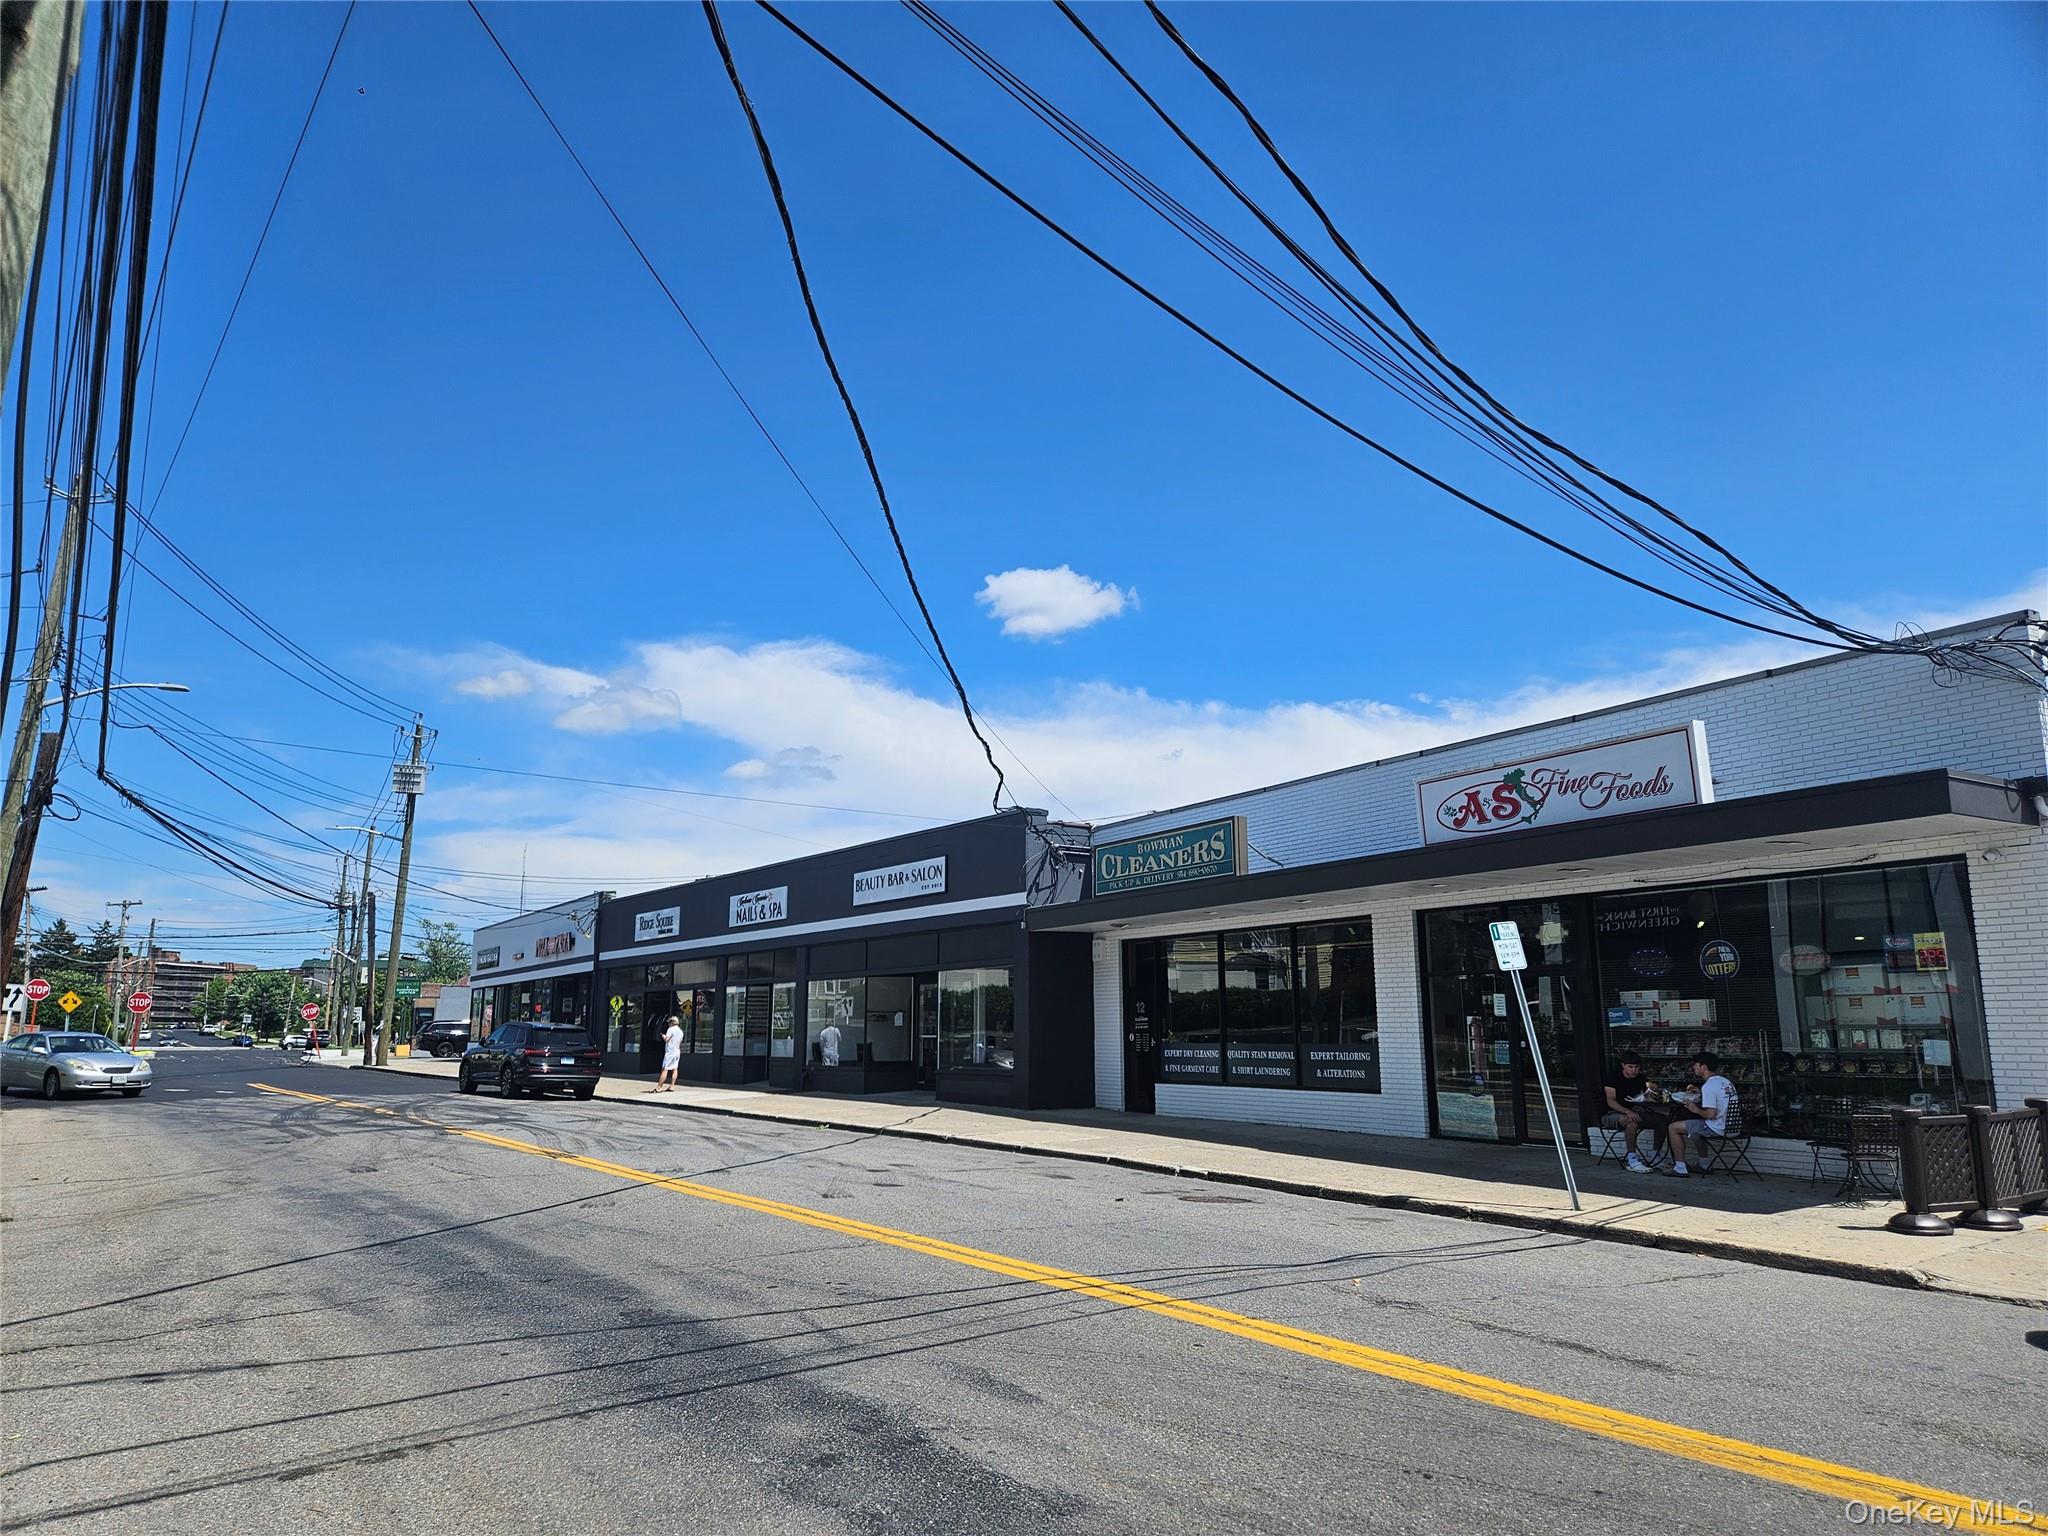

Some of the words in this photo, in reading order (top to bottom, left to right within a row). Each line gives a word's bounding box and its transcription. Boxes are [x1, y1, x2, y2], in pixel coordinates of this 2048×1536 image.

[1531, 767, 1589, 804] Fine
[1579, 764, 1674, 810] Foods
[1137, 835, 1184, 854] BOWMAN
[1101, 829, 1225, 879] CLEANERS
[855, 874, 886, 893] BEAUTY
[887, 871, 904, 887] BAR
[904, 873, 910, 882] &
[911, 864, 943, 884] SALON
[1109, 877, 1134, 890] PICK-UP
[1143, 871, 1174, 884] DELIVERY
[736, 905, 758, 924] NAILS
[759, 904, 766, 919] &
[769, 902, 783, 918] SPA
[639, 916, 654, 932] RIDGE
[1719, 953, 1735, 962] YORK
[1705, 961, 1737, 975] LOTTERY
[26, 985, 49, 994] STOP
[129, 998, 150, 1007] STOP
[302, 1007, 318, 1017] STOP
[1164, 1050, 1182, 1058] EXPERT
[1183, 1050, 1193, 1058] DRY
[1193, 1050, 1219, 1058] CLEANING
[1227, 1050, 1250, 1060] QUALITY
[1251, 1051, 1266, 1060] STAIN
[1267, 1051, 1295, 1060] REMOVAL
[1310, 1052, 1333, 1061] EXPERT
[1334, 1052, 1371, 1061] TAILORING
[1169, 1065, 1181, 1073] FINE
[1181, 1065, 1205, 1073] GARMENT
[1205, 1066, 1219, 1074] CARE
[1237, 1067, 1254, 1075] SHIRT
[1254, 1067, 1291, 1077] LAUNDERING
[1316, 1069, 1322, 1077] &
[1322, 1069, 1365, 1079] ALTERATIONS
